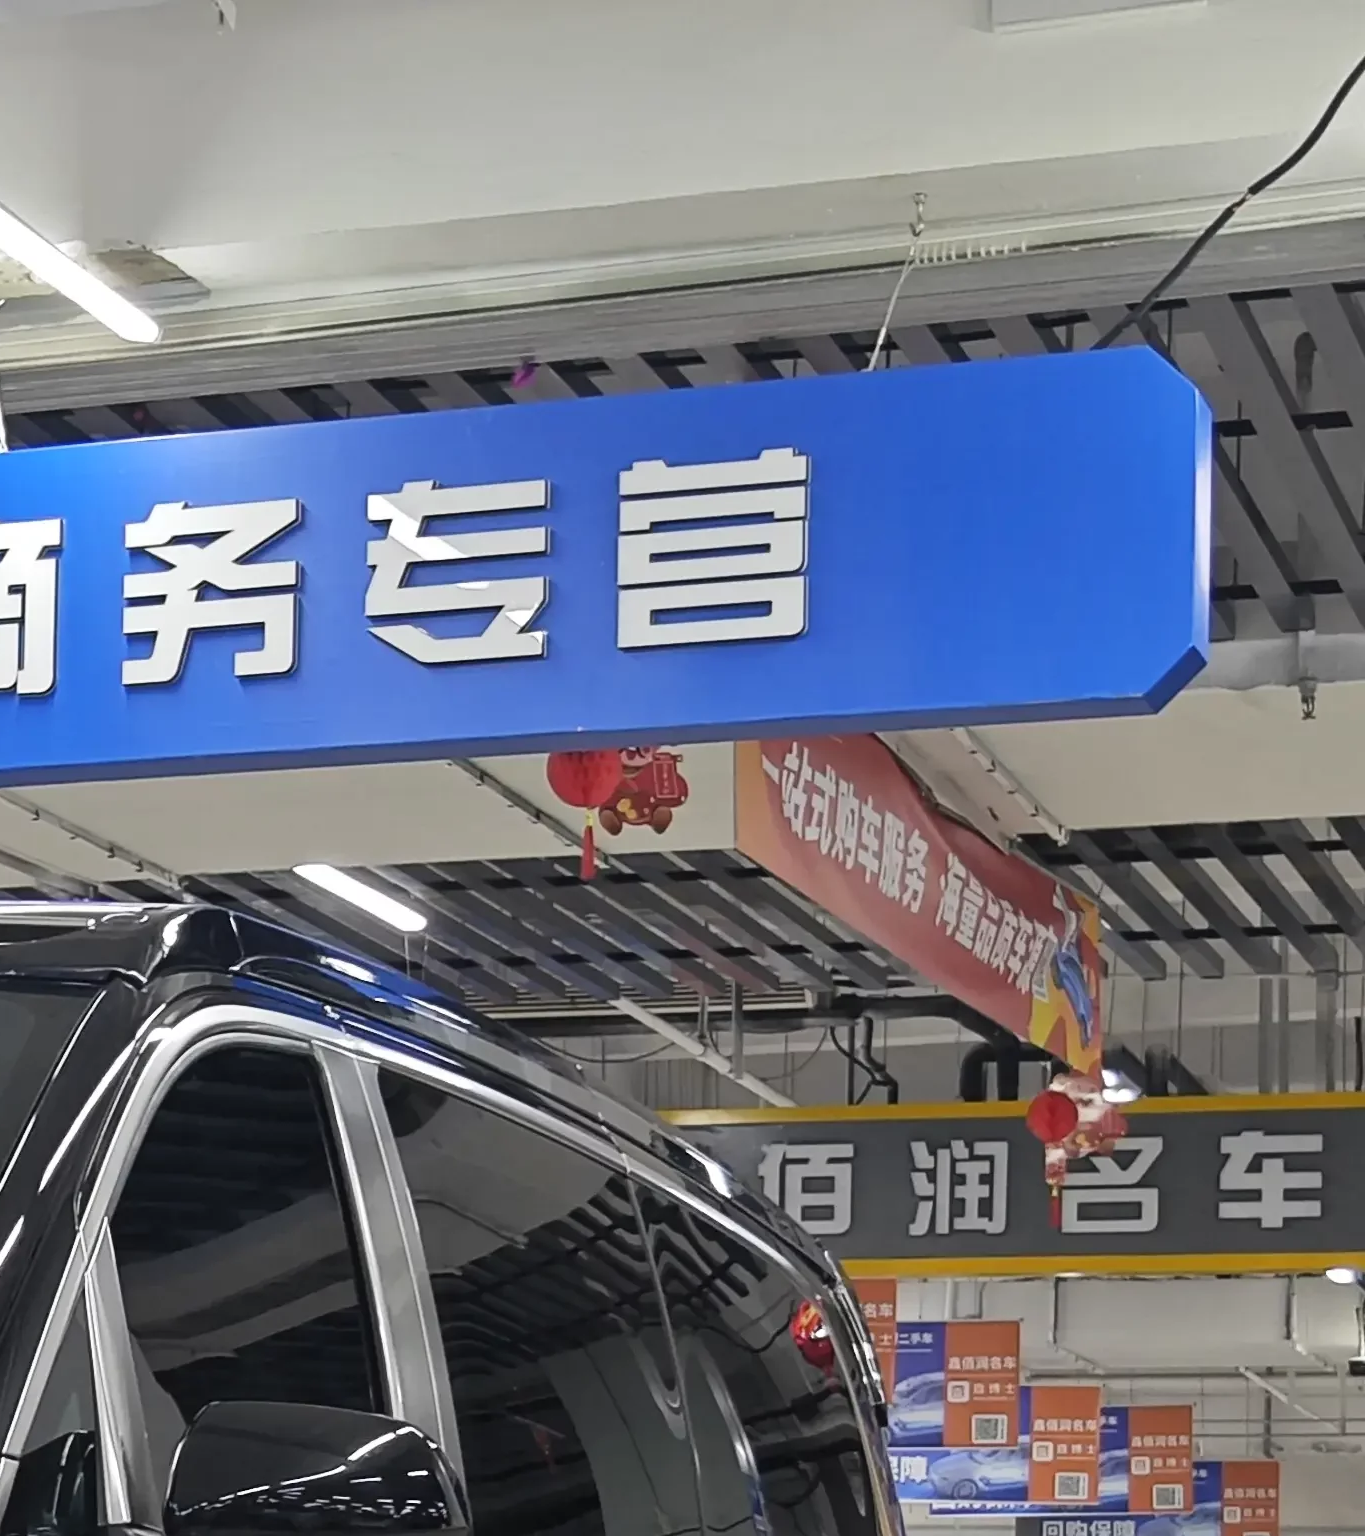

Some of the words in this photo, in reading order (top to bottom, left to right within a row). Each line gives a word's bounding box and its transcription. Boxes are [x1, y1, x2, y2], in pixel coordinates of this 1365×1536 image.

[762, 742, 928, 914] 一站式购车服务
[759, 1130, 1323, 1236] 佰润名车
[860, 1302, 894, 1318] 名车
